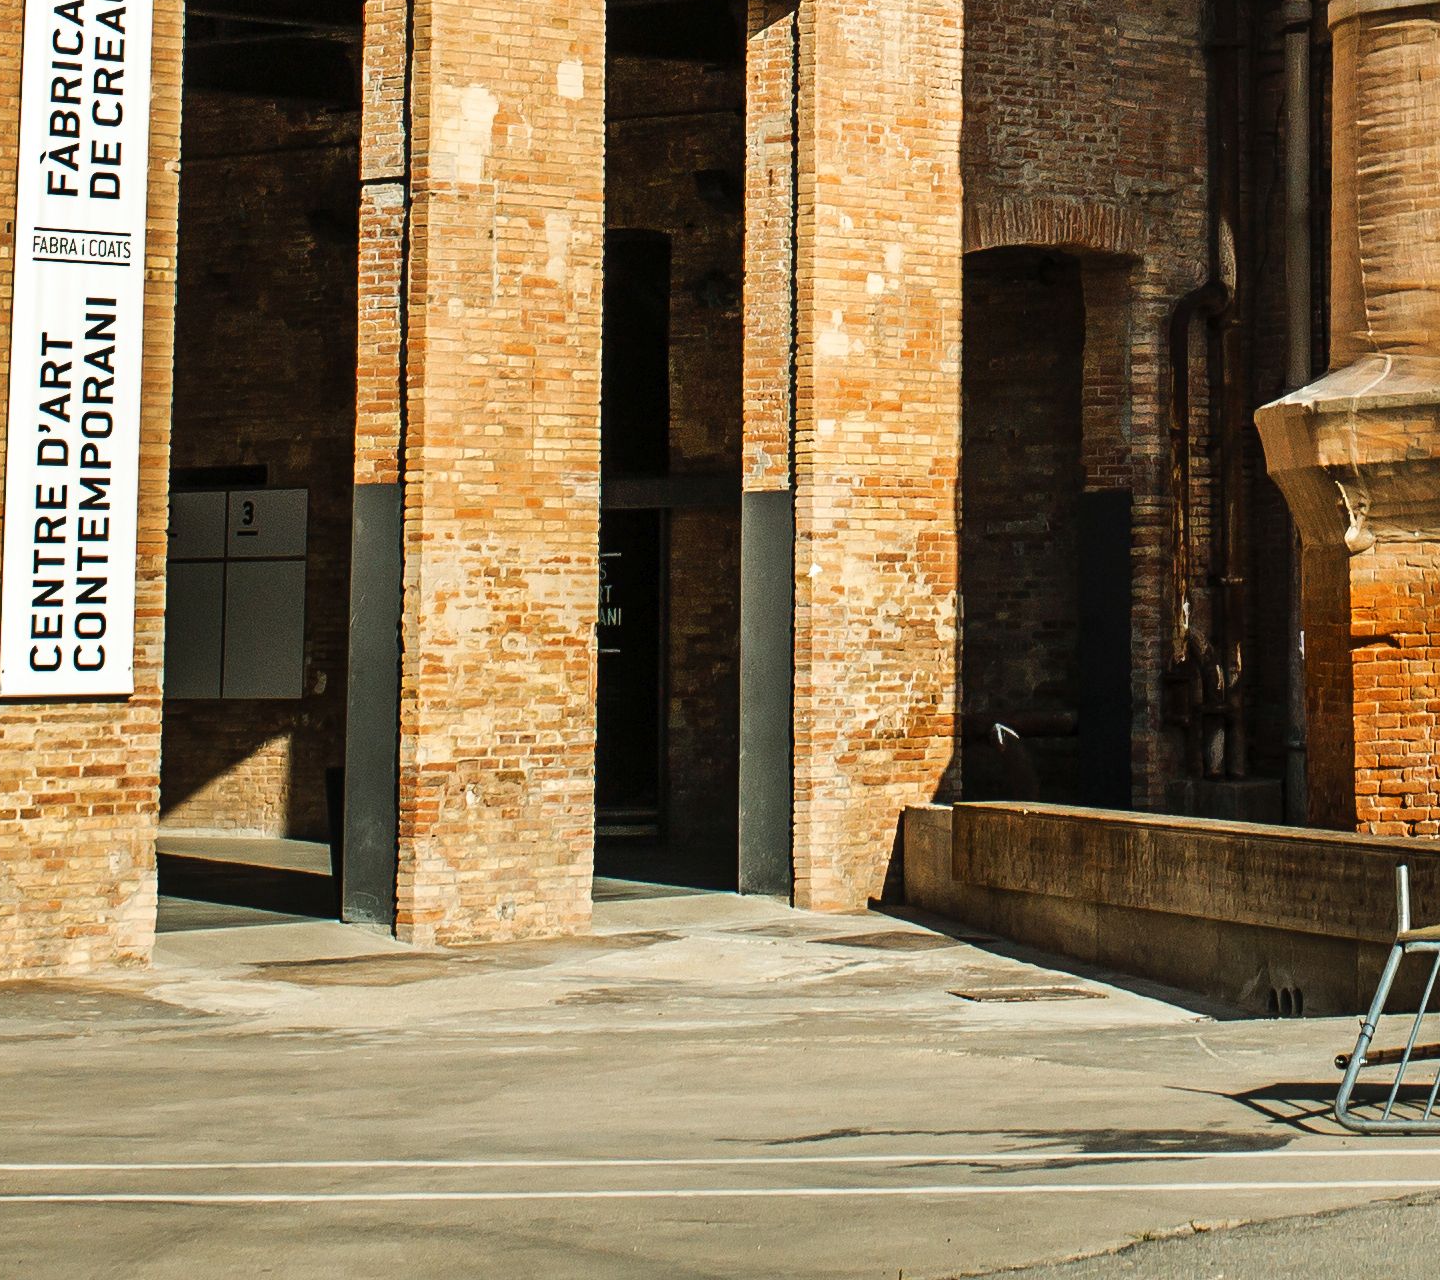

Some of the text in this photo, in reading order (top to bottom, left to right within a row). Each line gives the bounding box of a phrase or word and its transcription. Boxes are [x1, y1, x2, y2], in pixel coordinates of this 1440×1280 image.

[90, 140, 122, 199] DE
[32, 235, 78, 255] FABRA
[89, 239, 131, 258] COATS
[29, 331, 73, 672] CENTRE D’ART
[73, 296, 117, 672] CONTEMPORANI
[242, 500, 255, 526] 3
